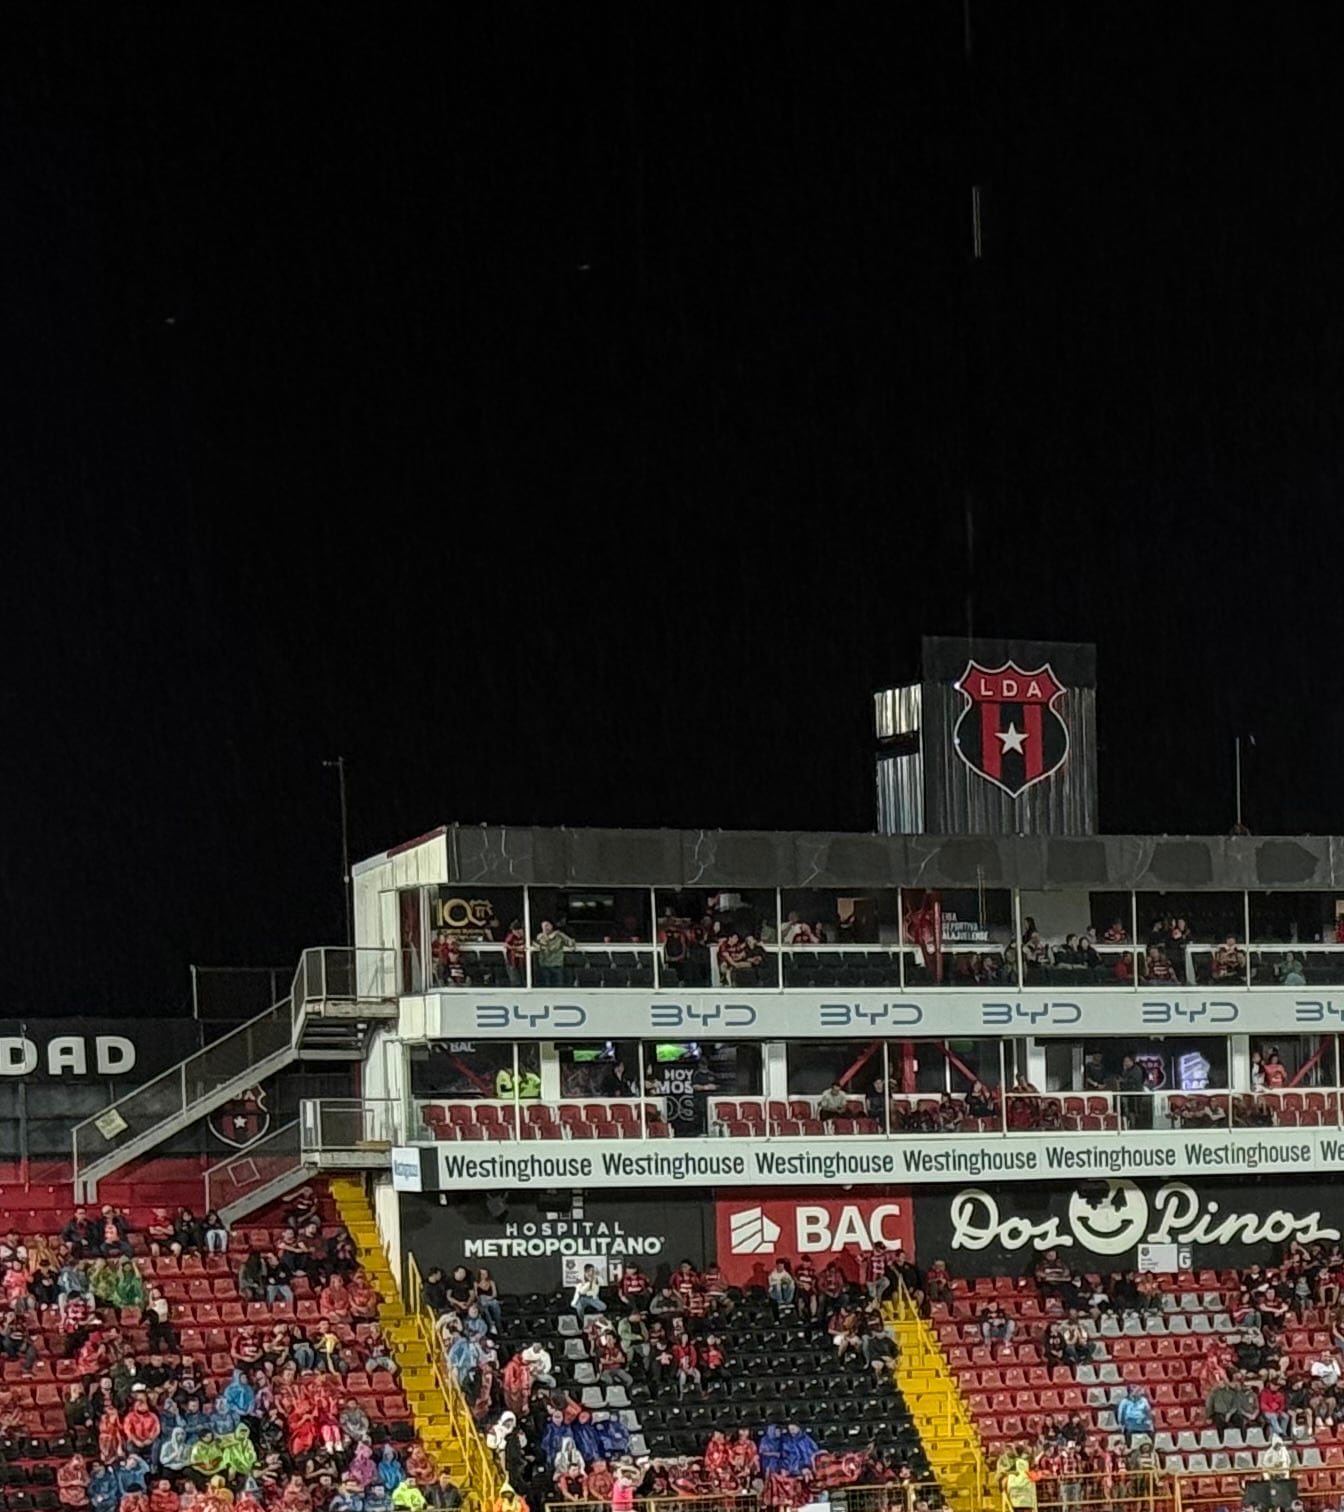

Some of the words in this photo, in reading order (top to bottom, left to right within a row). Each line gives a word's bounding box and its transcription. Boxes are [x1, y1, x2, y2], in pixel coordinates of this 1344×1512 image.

[980, 678, 1042, 698] LDA
[476, 1005, 586, 1028] BYD
[651, 1004, 757, 1027] BYD
[820, 1003, 922, 1026] BYD
[982, 1002, 1081, 1025] BYD
[1142, 1001, 1238, 1024] BYD
[0, 1036, 136, 1075] DAD
[445, 1154, 592, 1182] Westinghouse
[602, 1153, 745, 1179] Westinghouse
[755, 1152, 893, 1178] Westinghouse
[903, 1149, 1037, 1175] Westinghouse
[1046, 1146, 1176, 1172] Westinghouse
[1185, 1143, 1311, 1168] Westinghouse
[951, 1188, 1074, 1250] Dos
[1147, 1181, 1341, 1245] Pinos
[506, 1222, 625, 1236] HOSPITAL
[795, 1204, 901, 1253] BAC
[464, 1236, 662, 1258] METROPOLITANO
[609, 1263, 623, 1282] H
[1179, 1253, 1192, 1269] G
